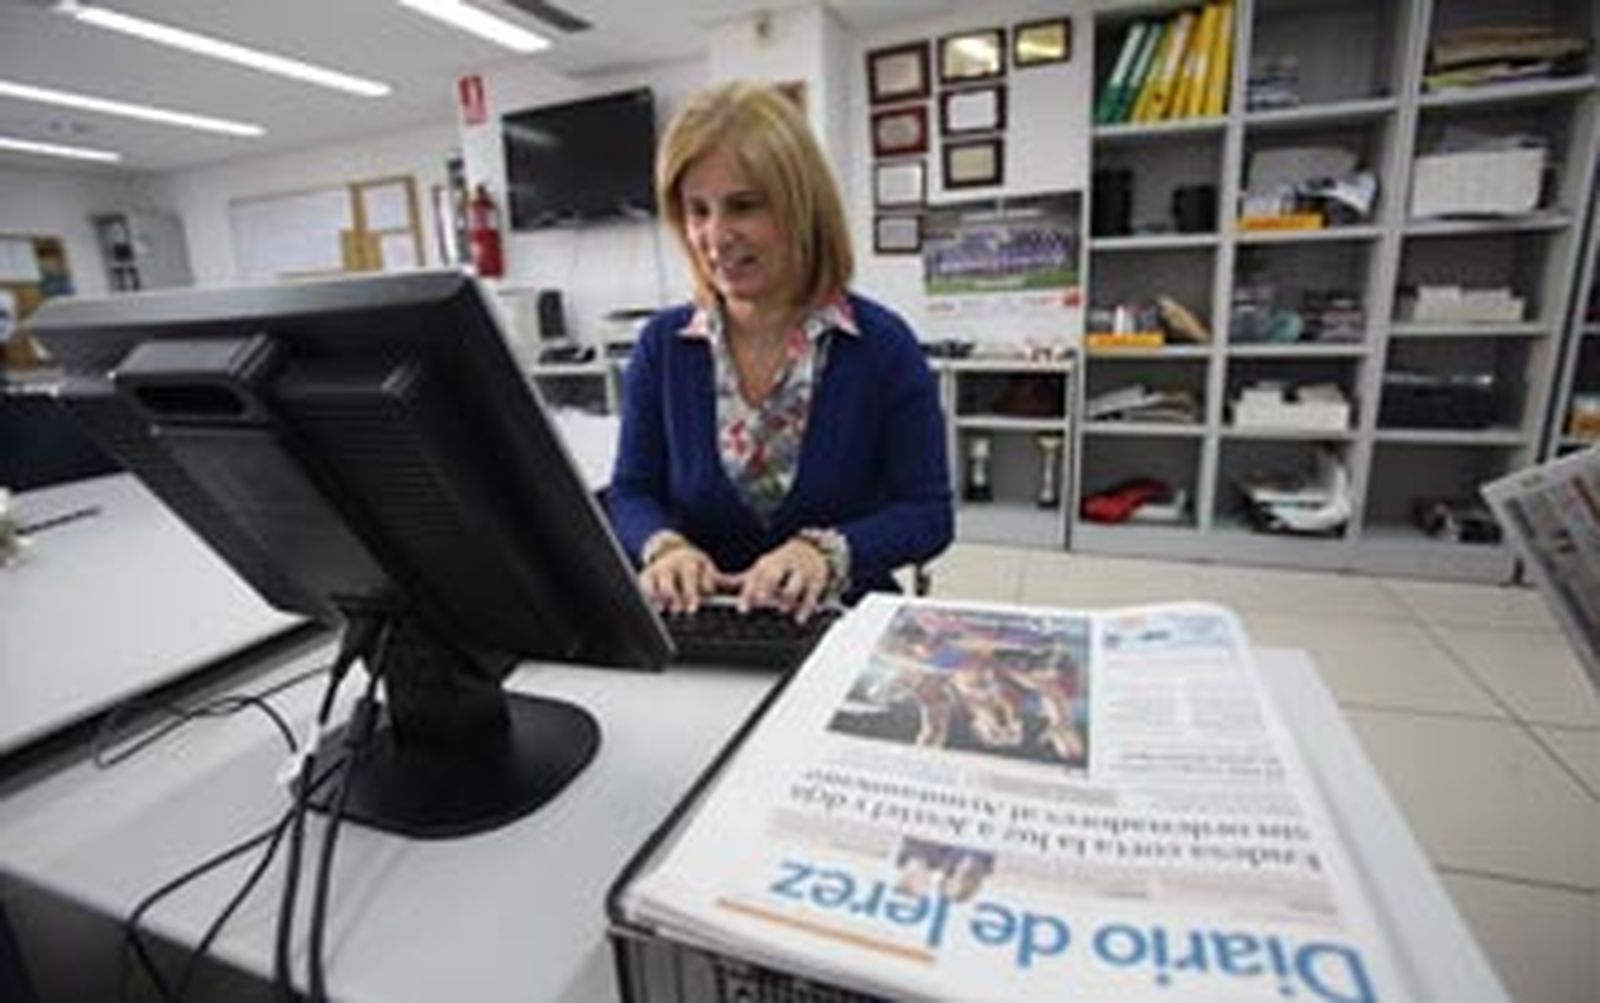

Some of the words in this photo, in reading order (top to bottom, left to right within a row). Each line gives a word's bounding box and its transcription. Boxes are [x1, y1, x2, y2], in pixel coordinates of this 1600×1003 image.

[769, 861, 948, 946] Jerez
[969, 902, 1071, 968] de
[1093, 922, 1378, 1003] Diario
